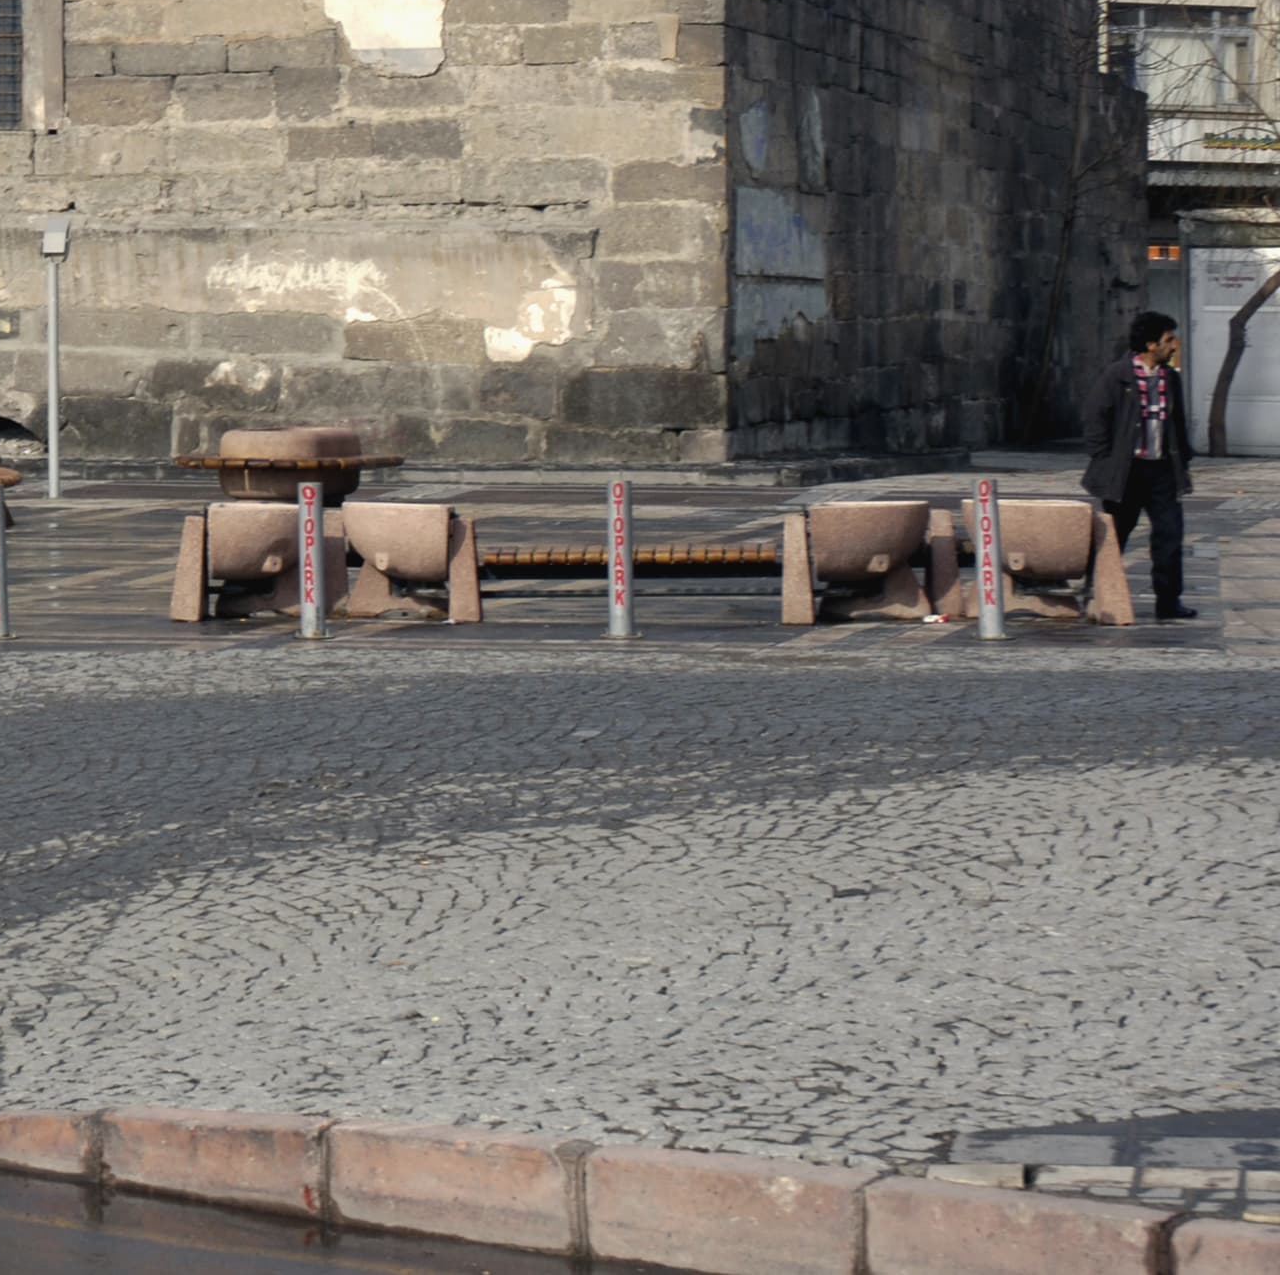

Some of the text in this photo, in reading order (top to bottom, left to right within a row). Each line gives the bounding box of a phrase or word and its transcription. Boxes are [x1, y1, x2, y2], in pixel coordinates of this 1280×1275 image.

[301, 484, 317, 605] OTOPARK
[612, 481, 628, 606] OTOPARK
[977, 479, 997, 606] OTOPARK
